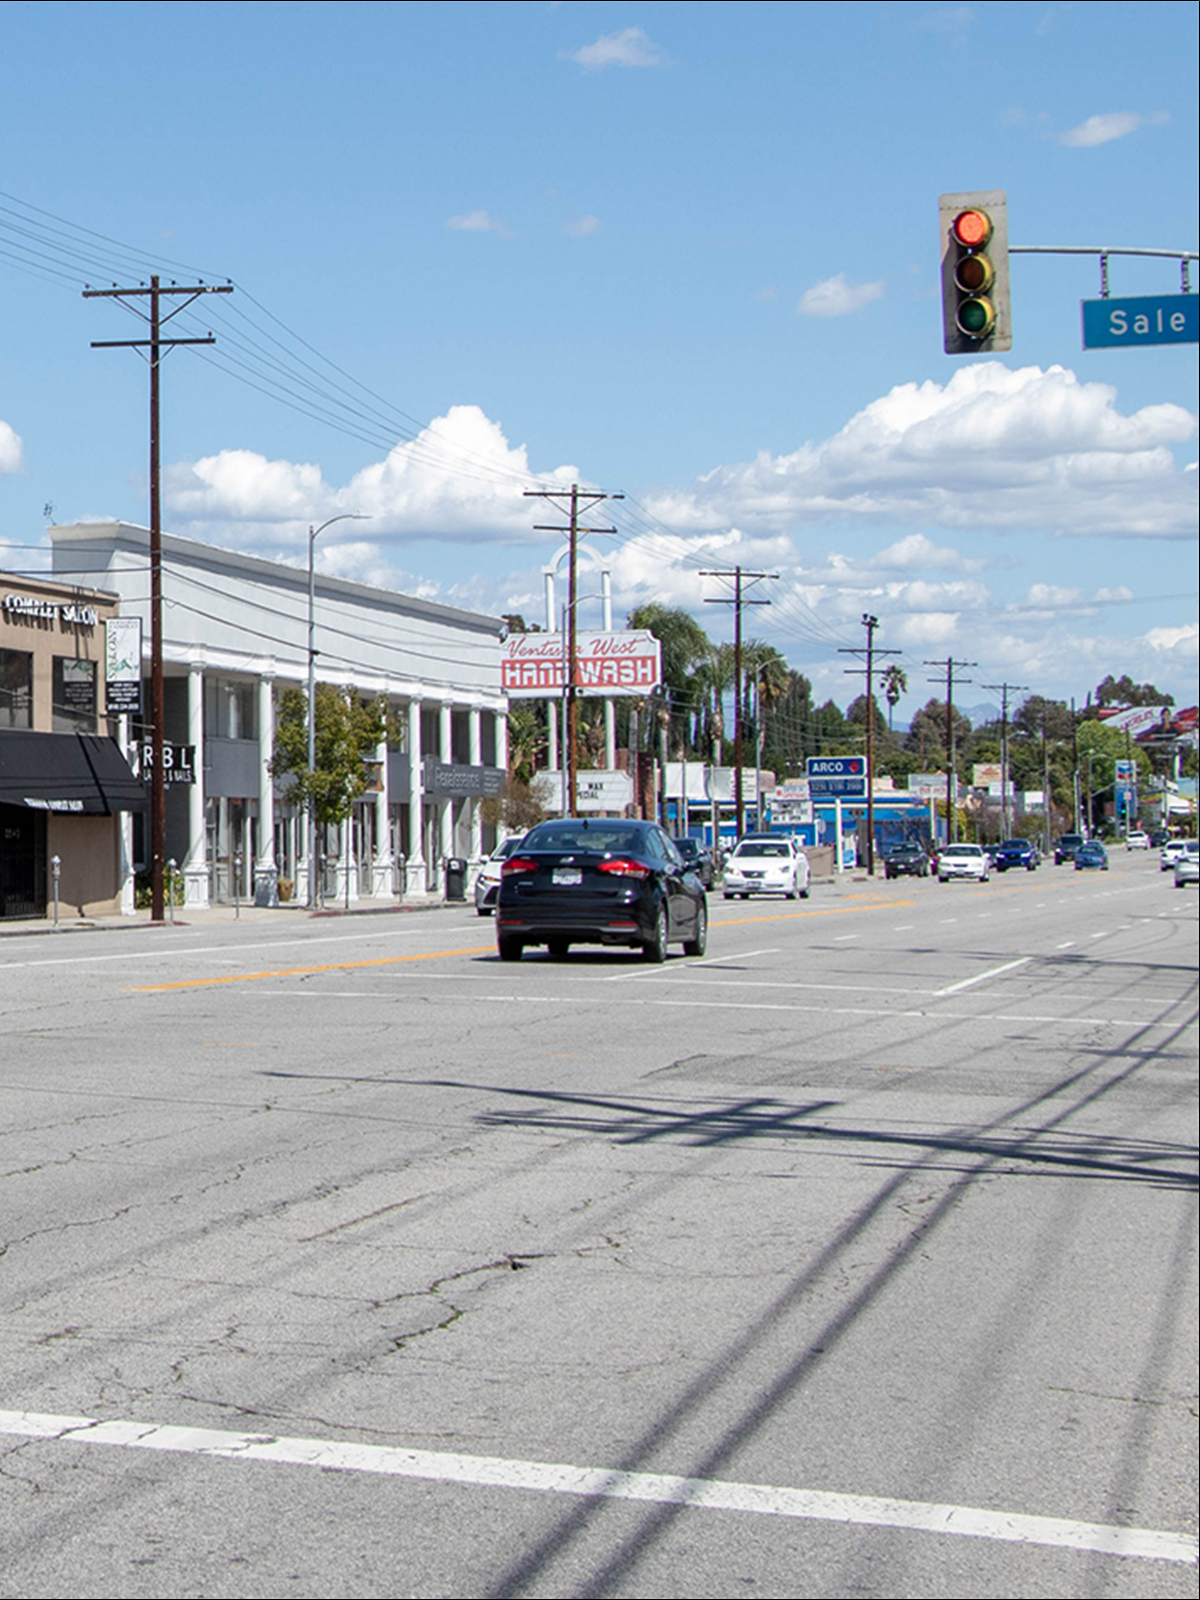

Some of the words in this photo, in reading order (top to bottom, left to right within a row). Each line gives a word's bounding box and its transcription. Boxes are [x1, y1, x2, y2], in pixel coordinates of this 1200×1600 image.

[1110, 308, 1186, 335] Sale
[6, 594, 58, 619] COMPLET
[63, 605, 99, 626] SALON
[507, 637, 583, 658] Ventua
[590, 637, 647, 656] West
[578, 659, 653, 685] WASH
[812, 761, 844, 773] ARCO
